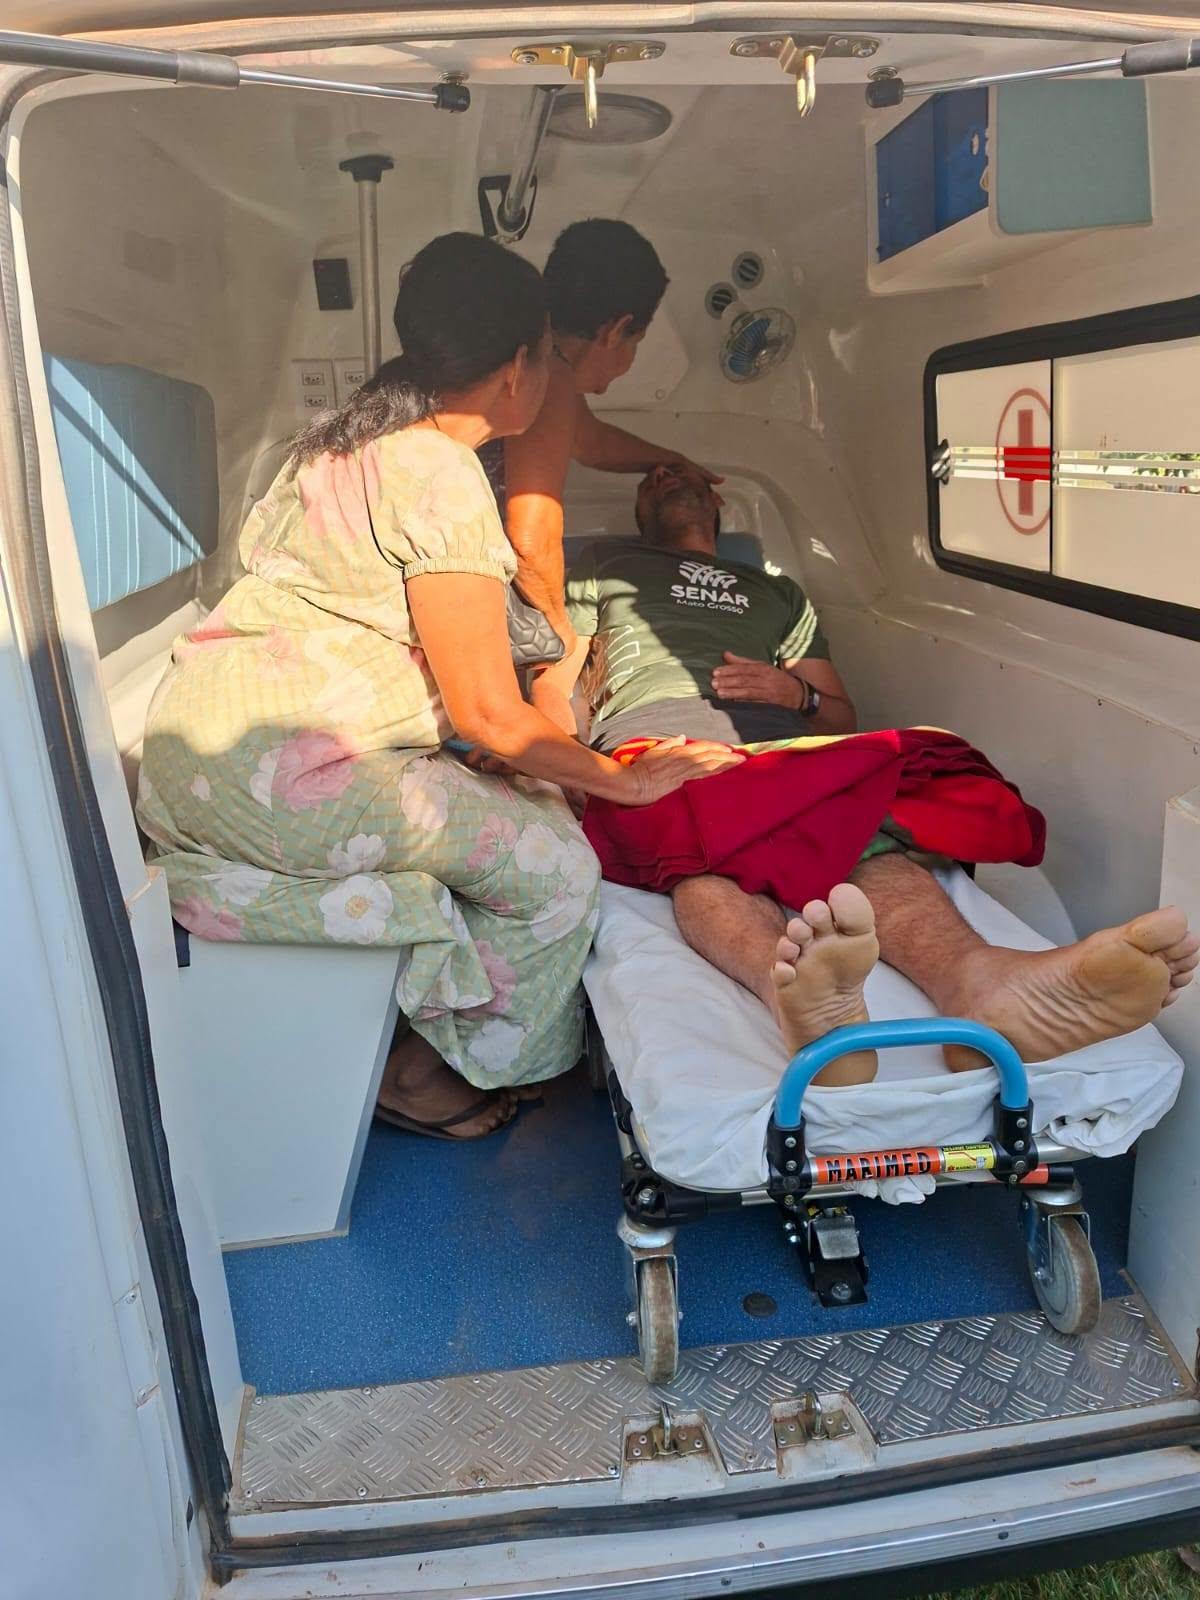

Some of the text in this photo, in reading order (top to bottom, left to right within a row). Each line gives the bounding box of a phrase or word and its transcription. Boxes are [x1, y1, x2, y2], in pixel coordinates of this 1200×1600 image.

[670, 585, 750, 608] SENAR
[676, 600, 744, 614] Mato Grosso
[826, 1152, 931, 1182] MARIMED
